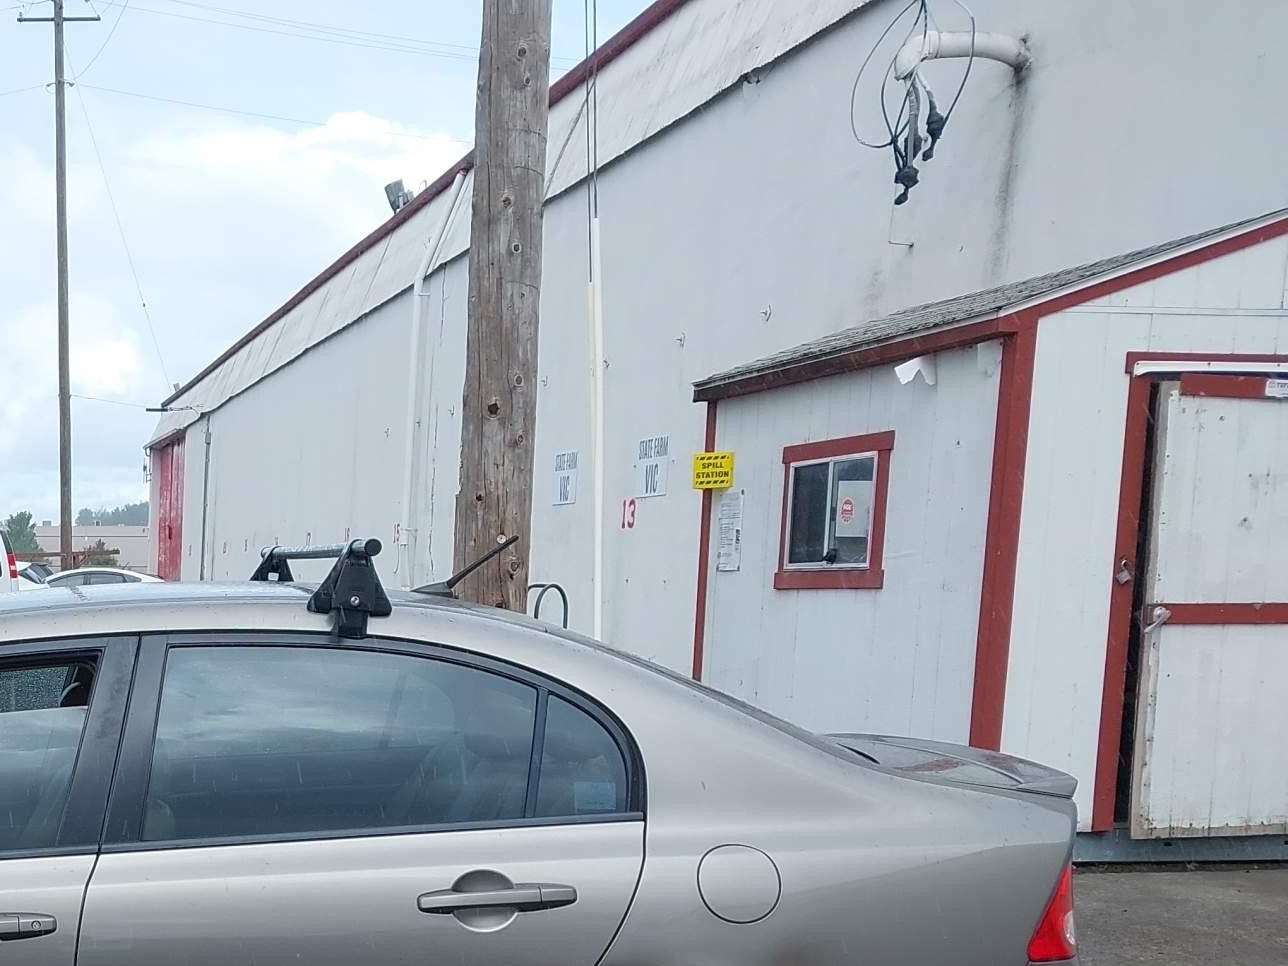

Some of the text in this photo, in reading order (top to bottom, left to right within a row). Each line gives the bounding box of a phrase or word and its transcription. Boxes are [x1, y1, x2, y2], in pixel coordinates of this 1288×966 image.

[695, 470, 729, 479] STATION
[701, 461, 724, 470] SPILL
[645, 463, 659, 494] VIC
[621, 499, 636, 528] 13
